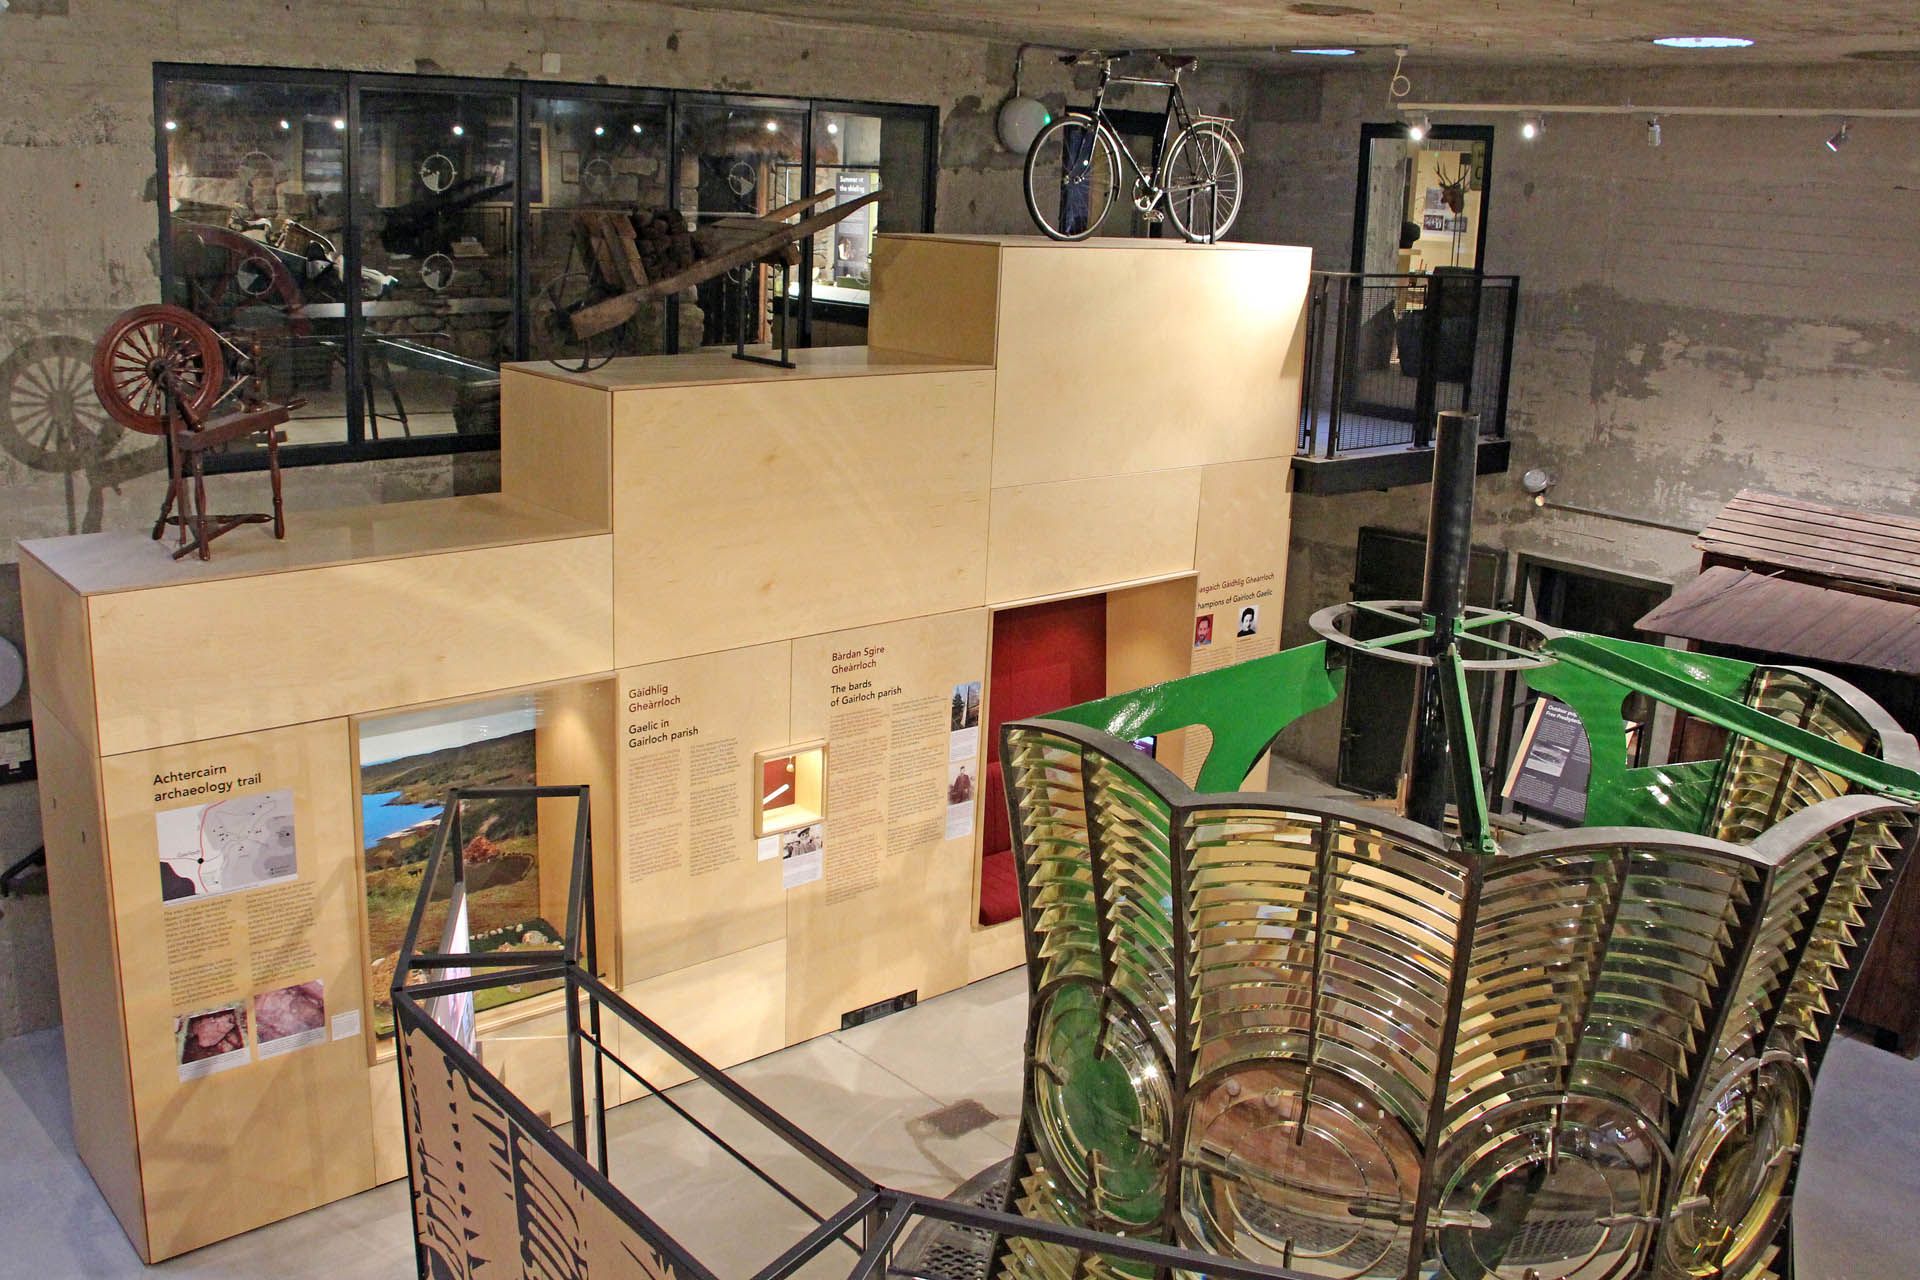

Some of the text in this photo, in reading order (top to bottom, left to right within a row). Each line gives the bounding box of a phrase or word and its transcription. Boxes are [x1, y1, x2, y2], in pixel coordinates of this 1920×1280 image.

[839, 184, 847, 192] the
[1197, 589, 1273, 609] hampions of Gairloch Gaelic
[830, 680, 872, 694] The bards
[830, 685, 902, 707] of Gairloch parish
[628, 719, 669, 734] Gaelic in
[628, 725, 699, 748] Gairloch parish
[153, 764, 227, 786] Achtercairn
[154, 773, 262, 802] archaeology trail
